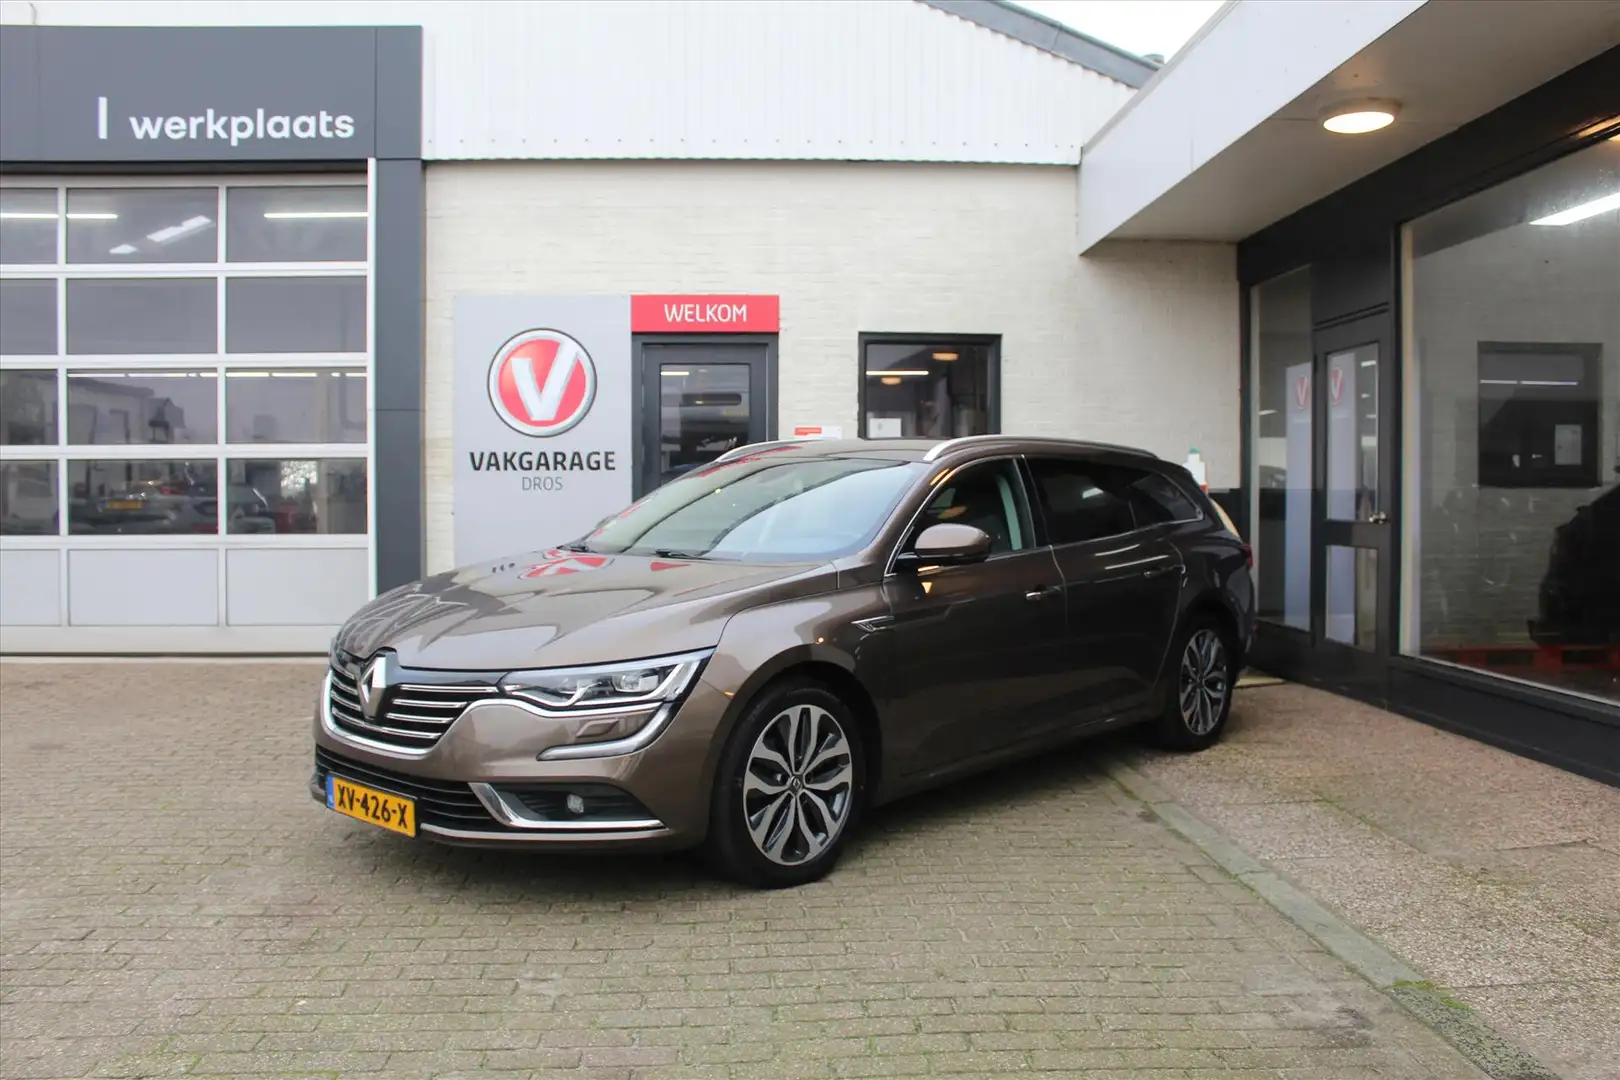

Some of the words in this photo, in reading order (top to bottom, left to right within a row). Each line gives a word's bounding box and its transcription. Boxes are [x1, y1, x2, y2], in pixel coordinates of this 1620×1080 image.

[129, 108, 355, 147] werkplaats
[663, 303, 748, 323] WELKOM
[509, 338, 579, 421] V
[469, 451, 616, 471] VAKGARAGE
[521, 476, 564, 491] DROS
[337, 783, 408, 829] XV-426-X
